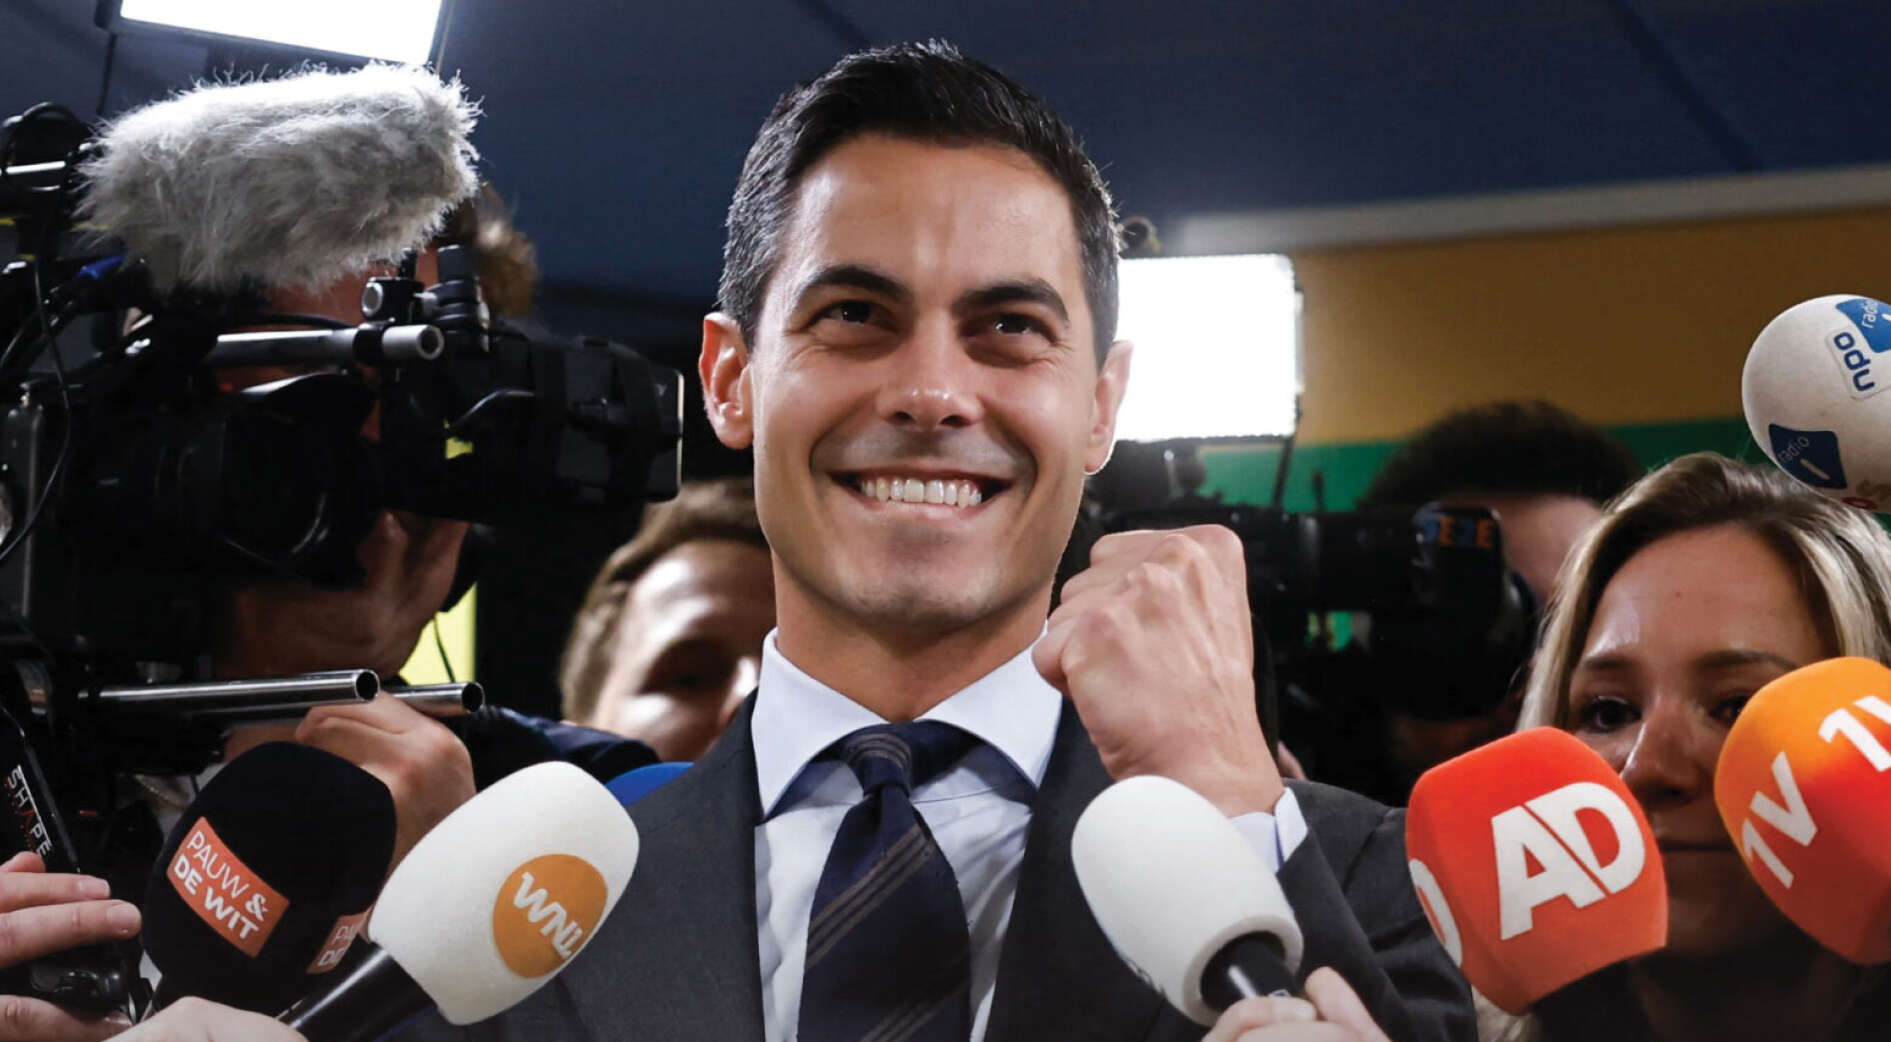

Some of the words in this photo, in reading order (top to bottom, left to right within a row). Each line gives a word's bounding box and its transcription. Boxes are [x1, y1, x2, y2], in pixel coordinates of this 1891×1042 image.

[1834, 332, 1875, 392] npo
[8, 766, 52, 857] SHAPE
[174, 854, 203, 896] DE
[203, 887, 260, 940] WIT
[187, 830, 249, 899] PAUW
[245, 893, 268, 922] &
[1491, 781, 1646, 941] AD
[512, 871, 584, 960] WNL
